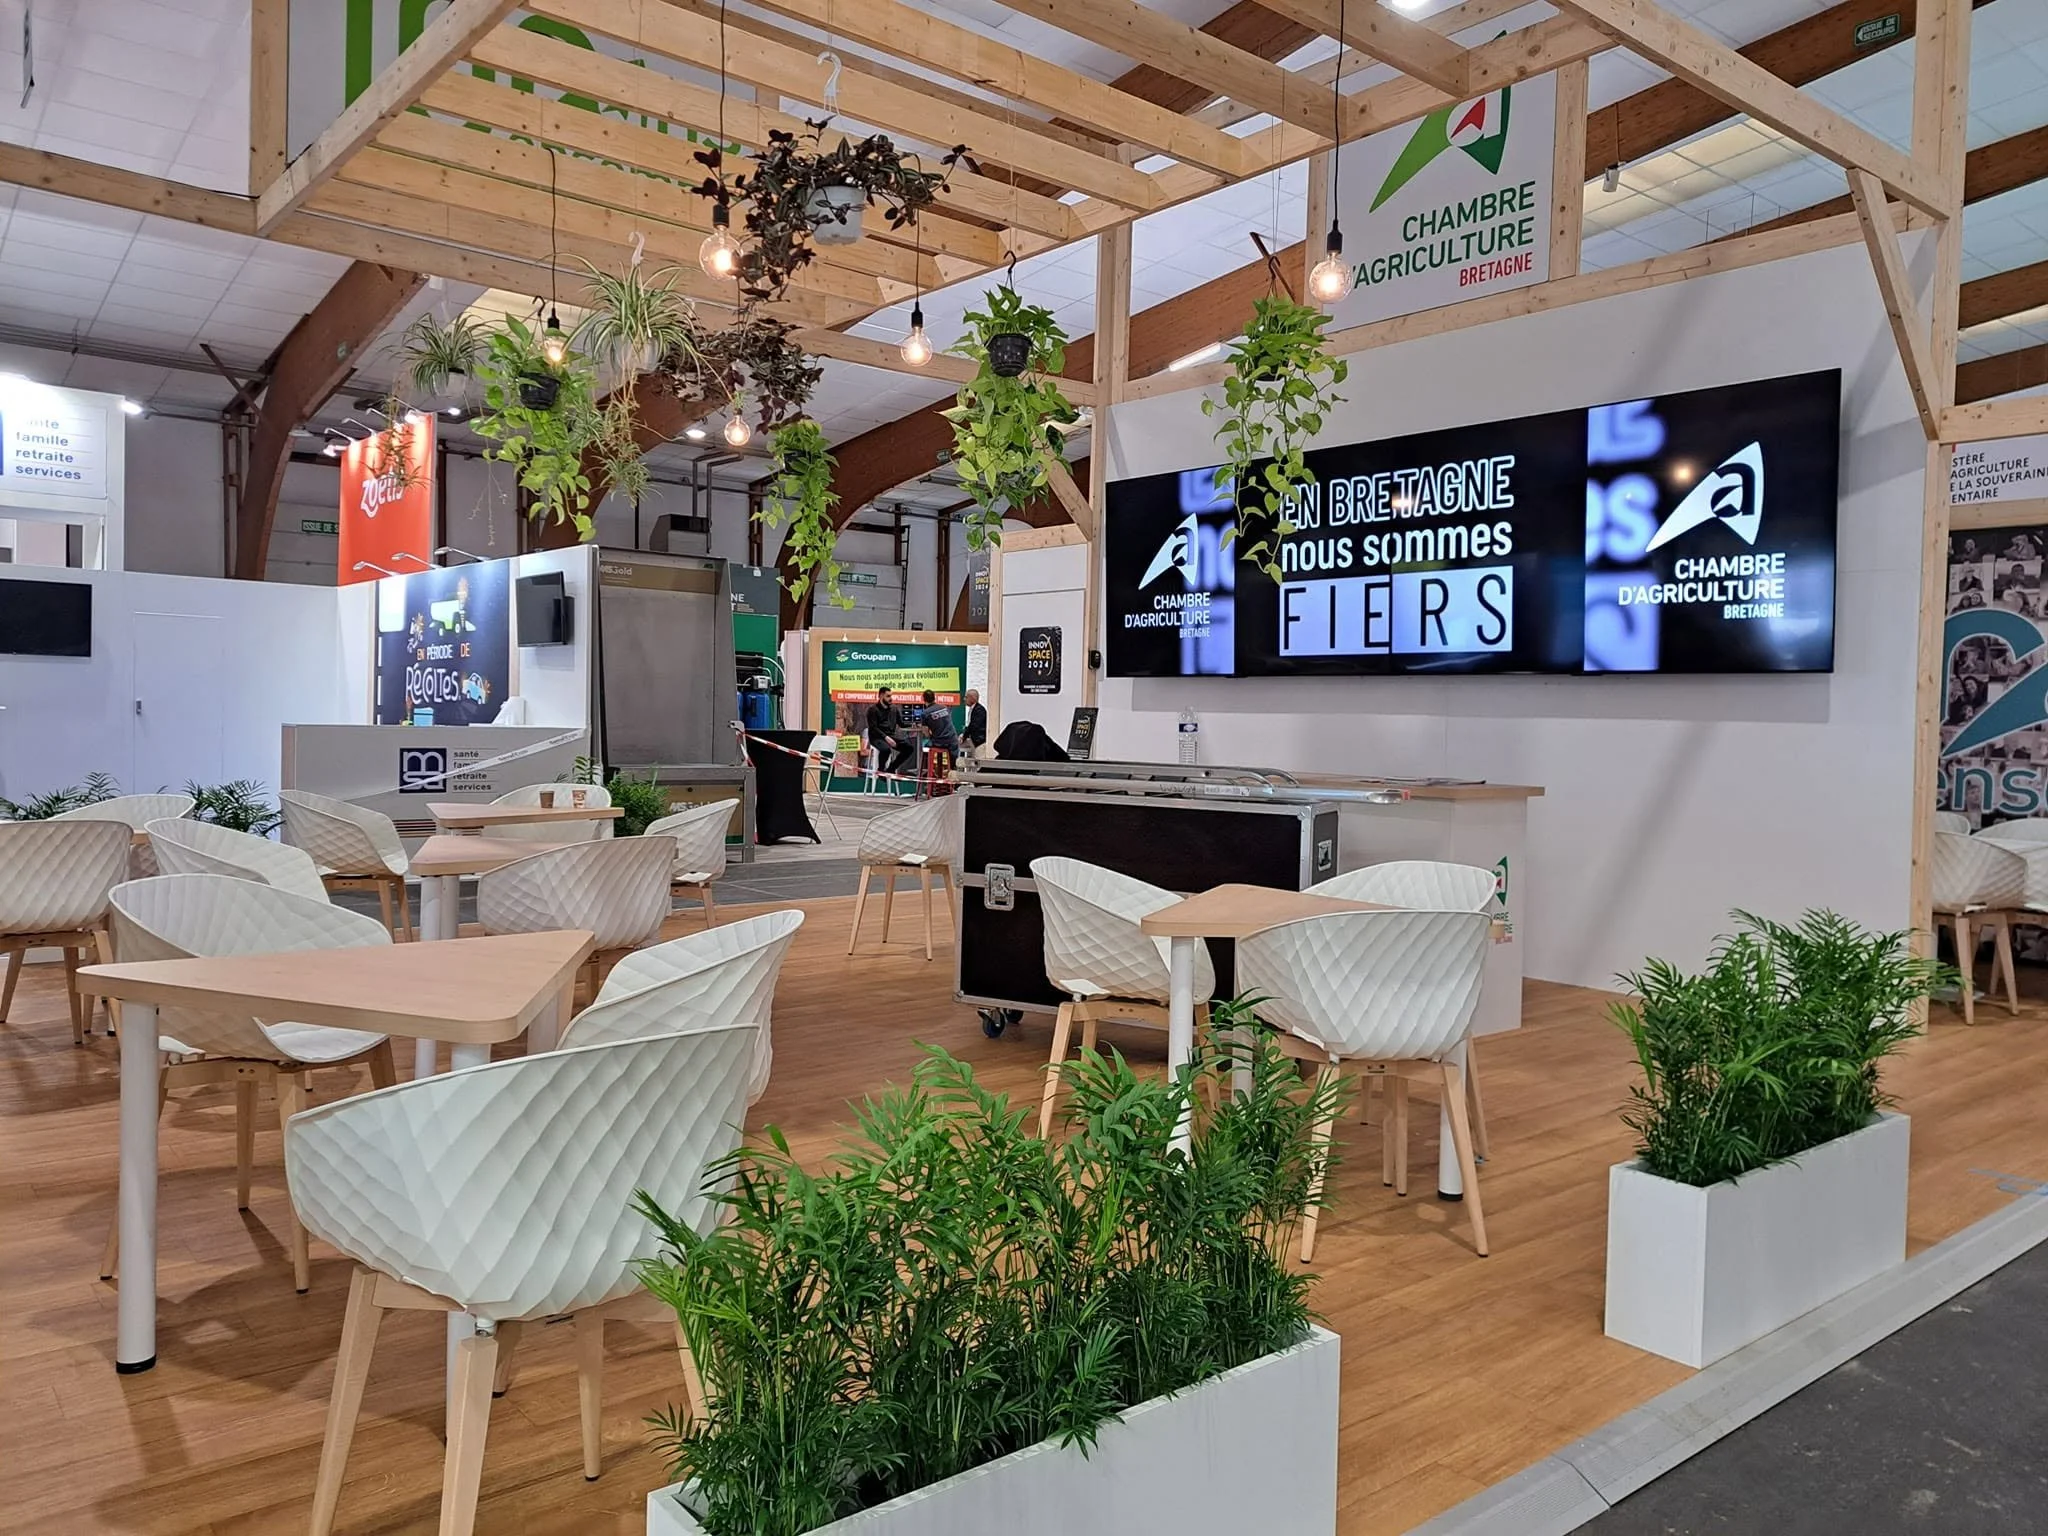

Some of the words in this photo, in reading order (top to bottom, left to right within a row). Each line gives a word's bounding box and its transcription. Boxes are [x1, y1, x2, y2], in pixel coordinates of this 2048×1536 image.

[1402, 180, 1536, 243] CHAMBRE
[1352, 216, 1535, 290] 'AGRICULTURE
[1459, 252, 1533, 287] BRETAGNE
[16, 432, 69, 447] famille
[15, 449, 74, 464] retraite
[15, 465, 82, 480] services
[1959, 480, 1973, 491] LA
[1976, 467, 2048, 489] SOUVERAIN
[1280, 481, 1321, 530] EN
[1329, 455, 1515, 527] BRETAGNE
[303, 522, 321, 532] ISSUE
[323, 523, 333, 532] DE
[1282, 536, 1353, 573] nous
[1363, 521, 1513, 567] sommes
[1674, 553, 1786, 580] CHAMBRE
[1618, 578, 1785, 606] D'AGRICULTURE
[1153, 592, 1211, 610] CHAMBRE
[972, 607, 988, 617] 202
[1283, 572, 1508, 650] FIERS
[1723, 603, 1784, 620] BRETAGNE
[1124, 610, 1211, 628] D'AGRICULTURE
[1179, 627, 1211, 639] BRETAGNE
[426, 643, 453, 660] PÉRIODE
[460, 642, 471, 658] DE
[1028, 641, 1049, 650] INNOV
[851, 651, 897, 662] Groupama
[1028, 650, 1051, 660] SPACE
[1028, 660, 1049, 669] 2024
[839, 673, 855, 682] Nous
[857, 674, 872, 682] nous
[873, 672, 902, 682] adaptons
[903, 673, 915, 681] aux
[916, 671, 949, 680] évolutions
[864, 682, 873, 690] du
[453, 750, 479, 758] santé
[453, 772, 488, 780] retraite
[452, 783, 491, 791] services
